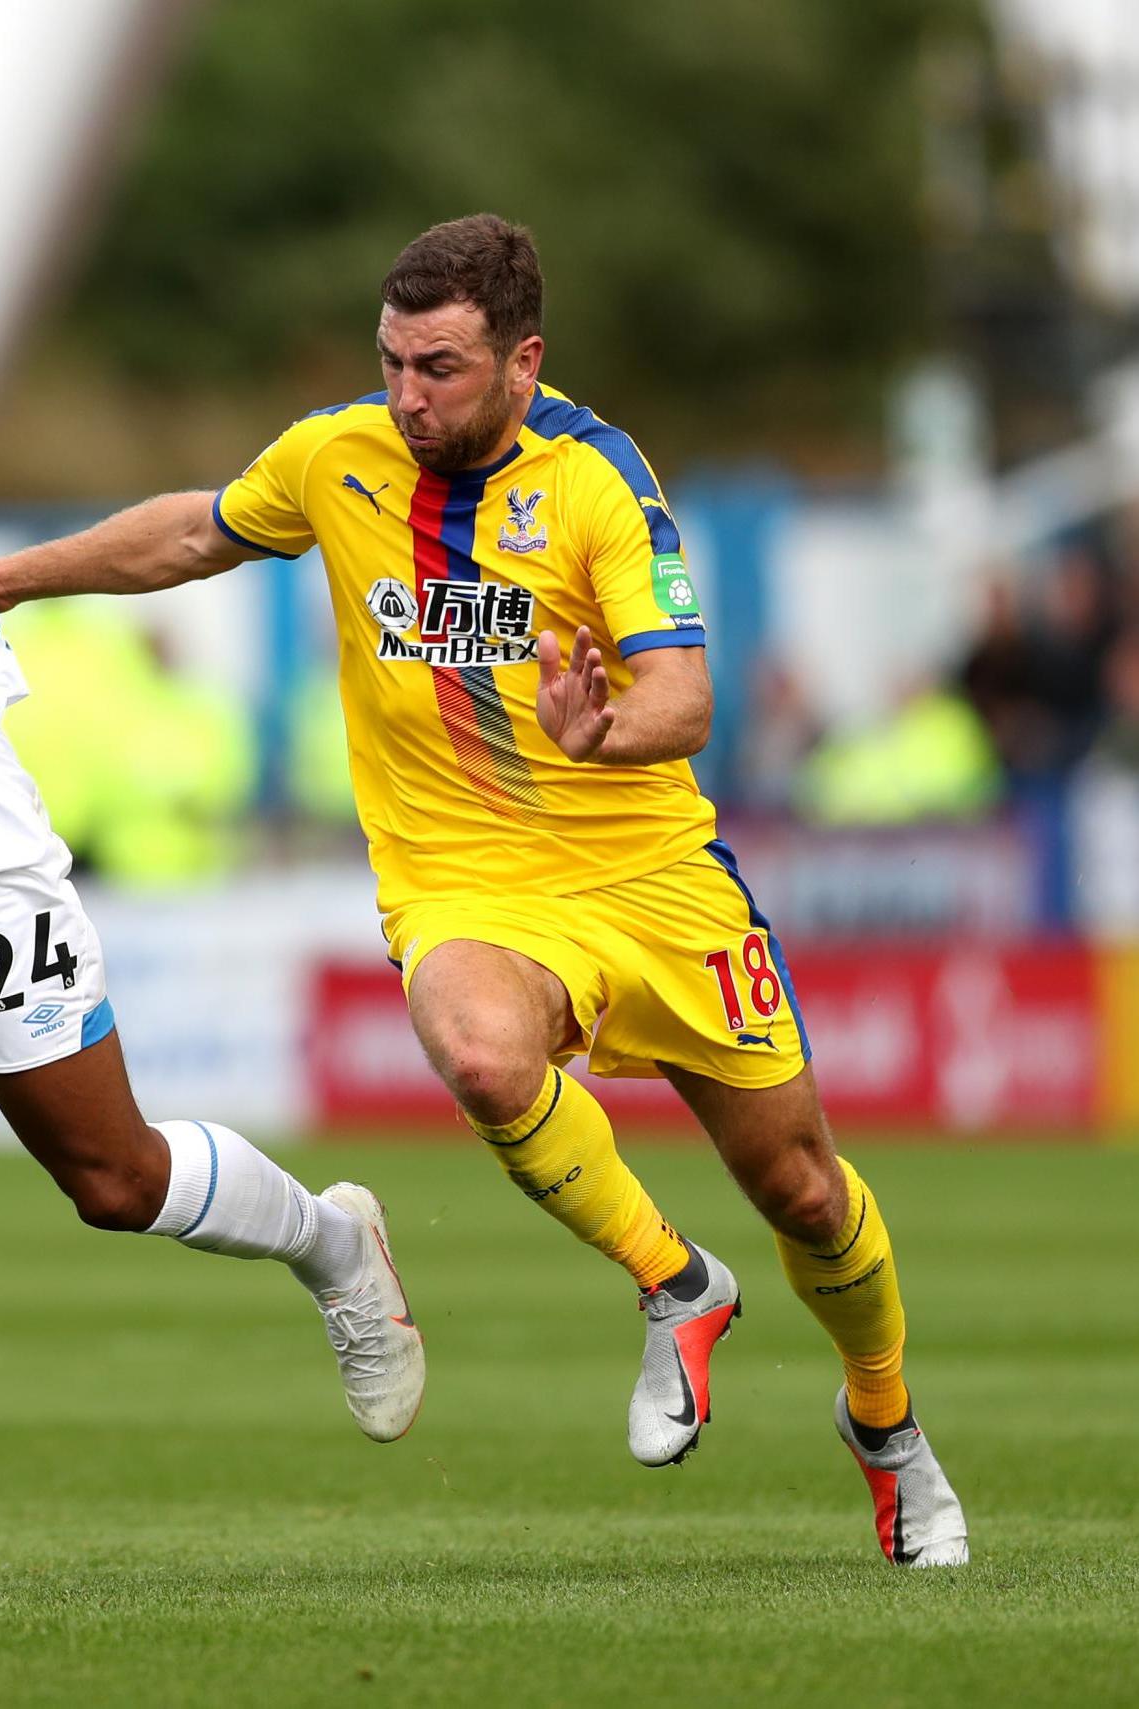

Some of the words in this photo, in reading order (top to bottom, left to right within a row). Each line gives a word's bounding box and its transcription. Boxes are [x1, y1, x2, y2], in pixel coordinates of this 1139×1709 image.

[424, 580, 533, 638] 万博
[704, 932, 781, 1032] 18
[30, 1019, 66, 1039] umbro
